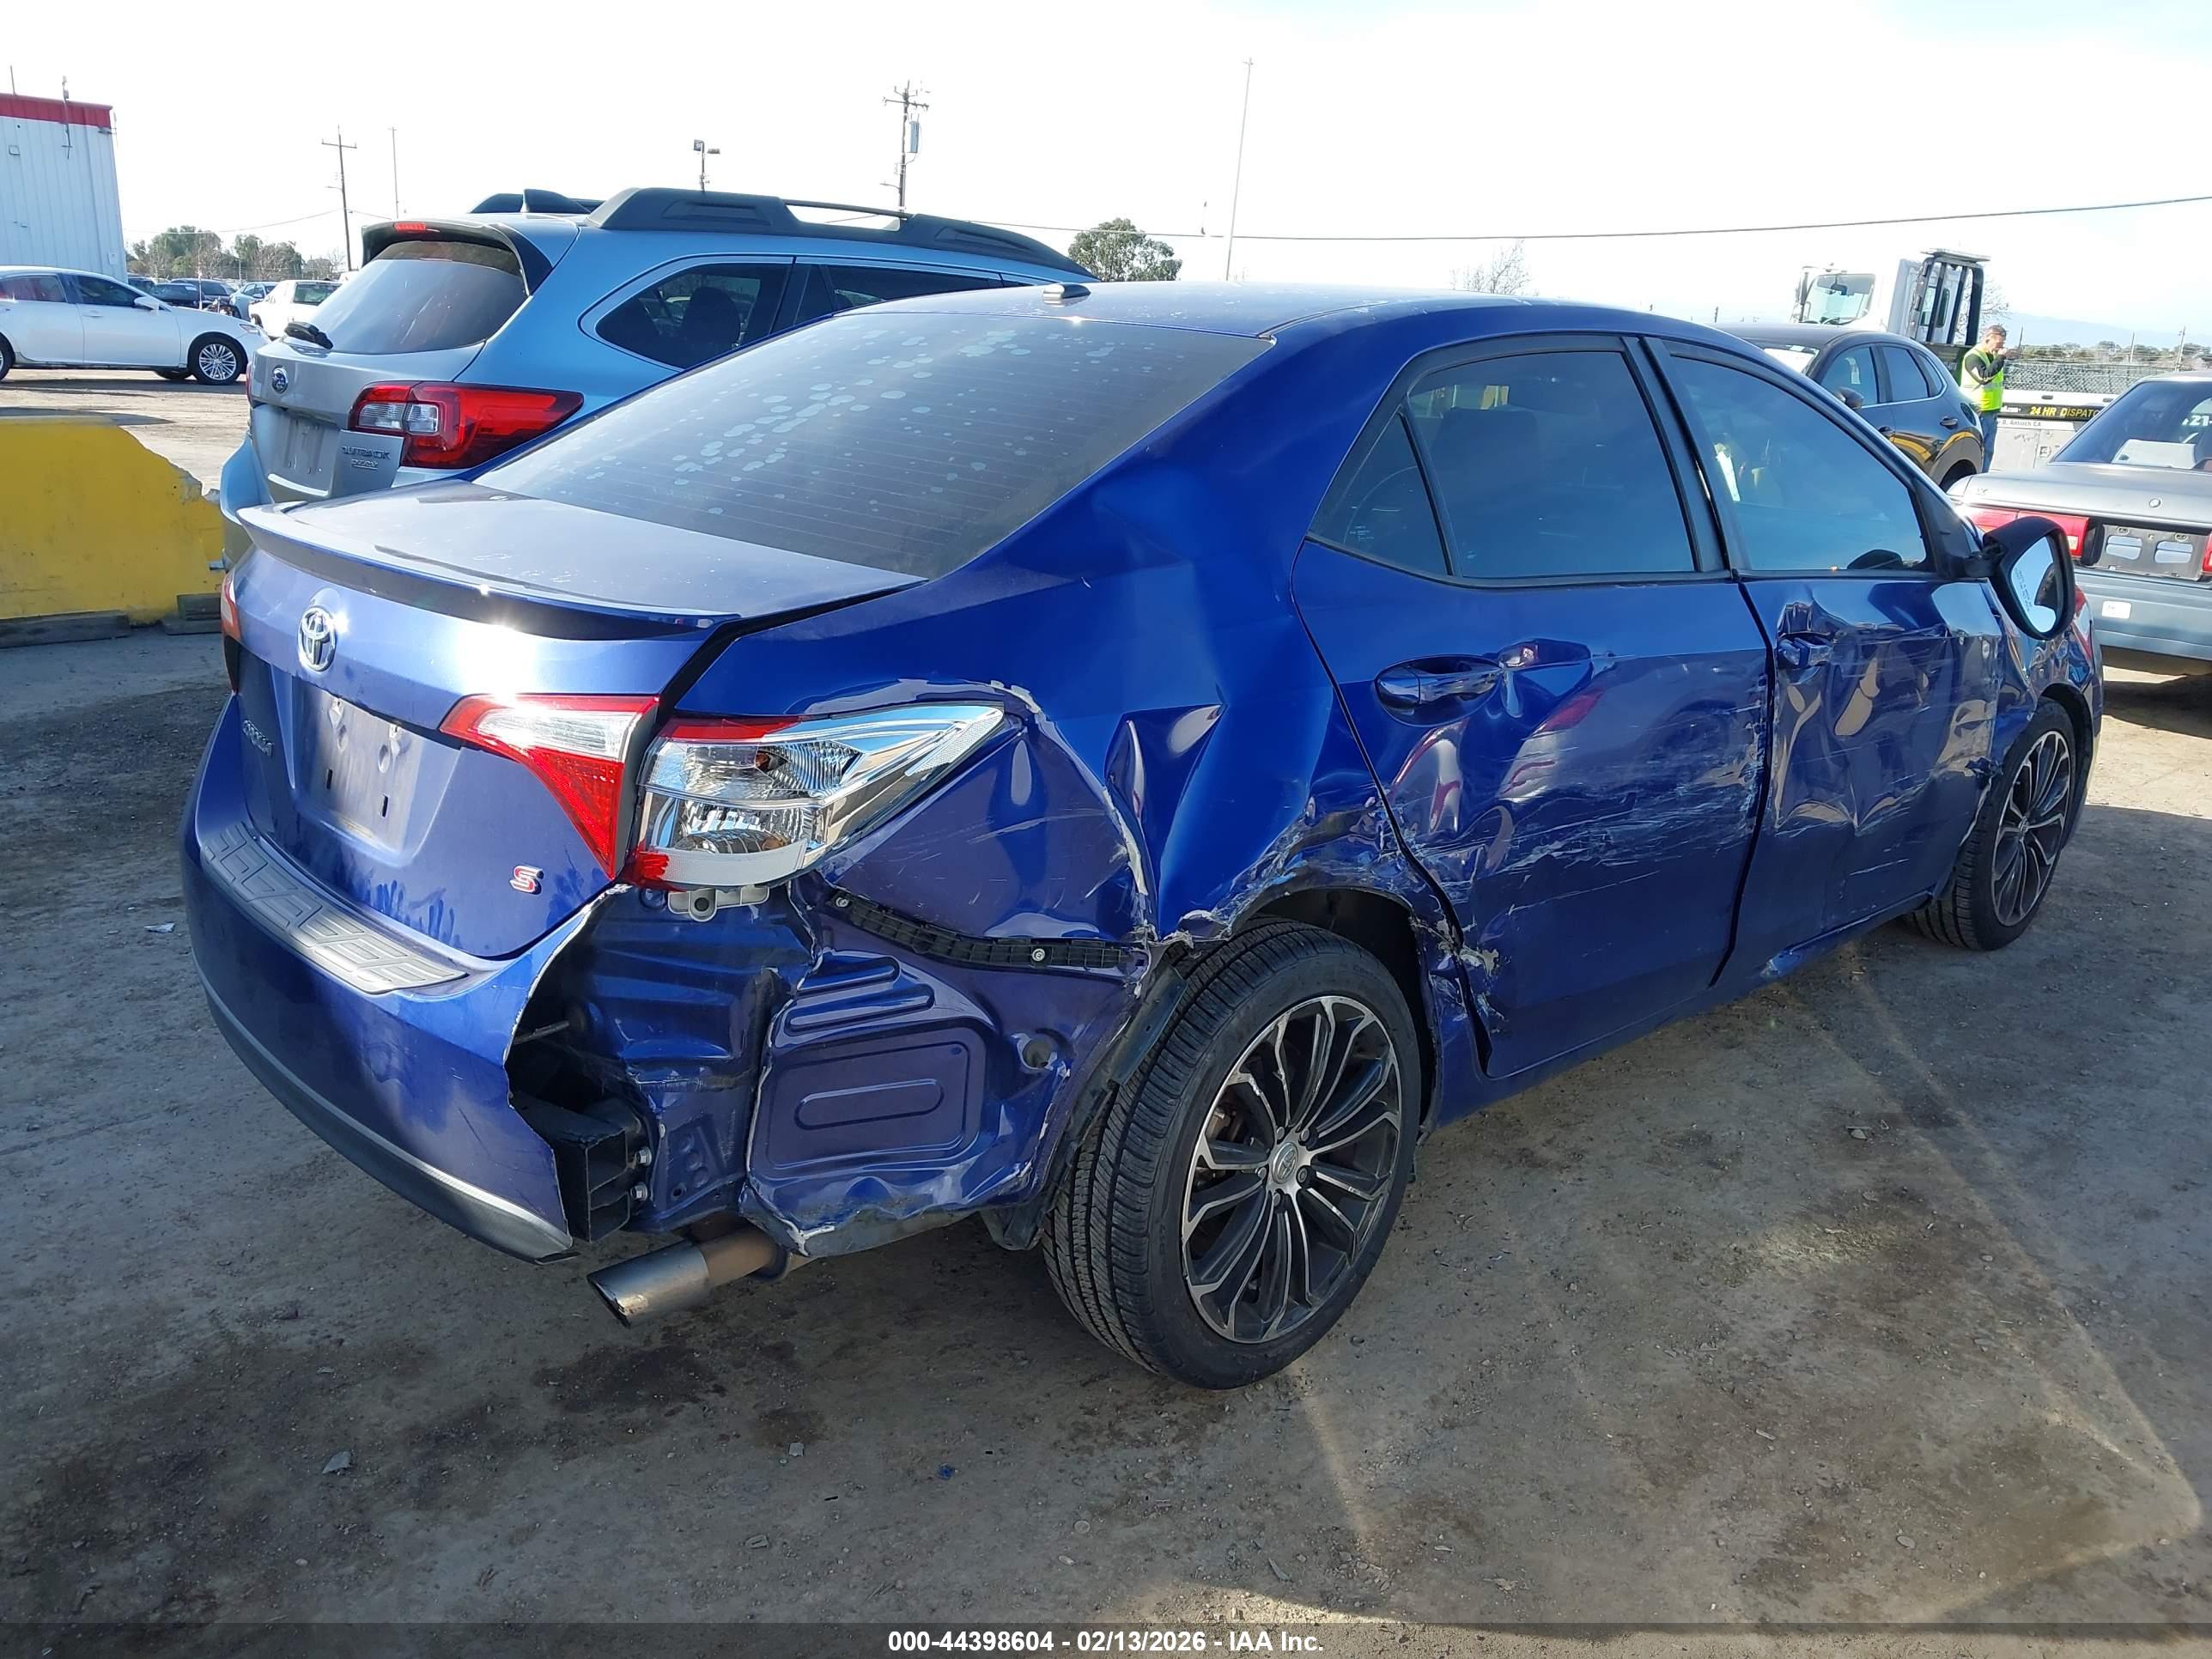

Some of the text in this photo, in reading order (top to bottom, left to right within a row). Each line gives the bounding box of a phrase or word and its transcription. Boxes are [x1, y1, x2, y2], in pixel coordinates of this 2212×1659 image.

[2030, 406, 2041, 416] 24
[2043, 407, 2057, 416] HR
[509, 865, 543, 894] S
